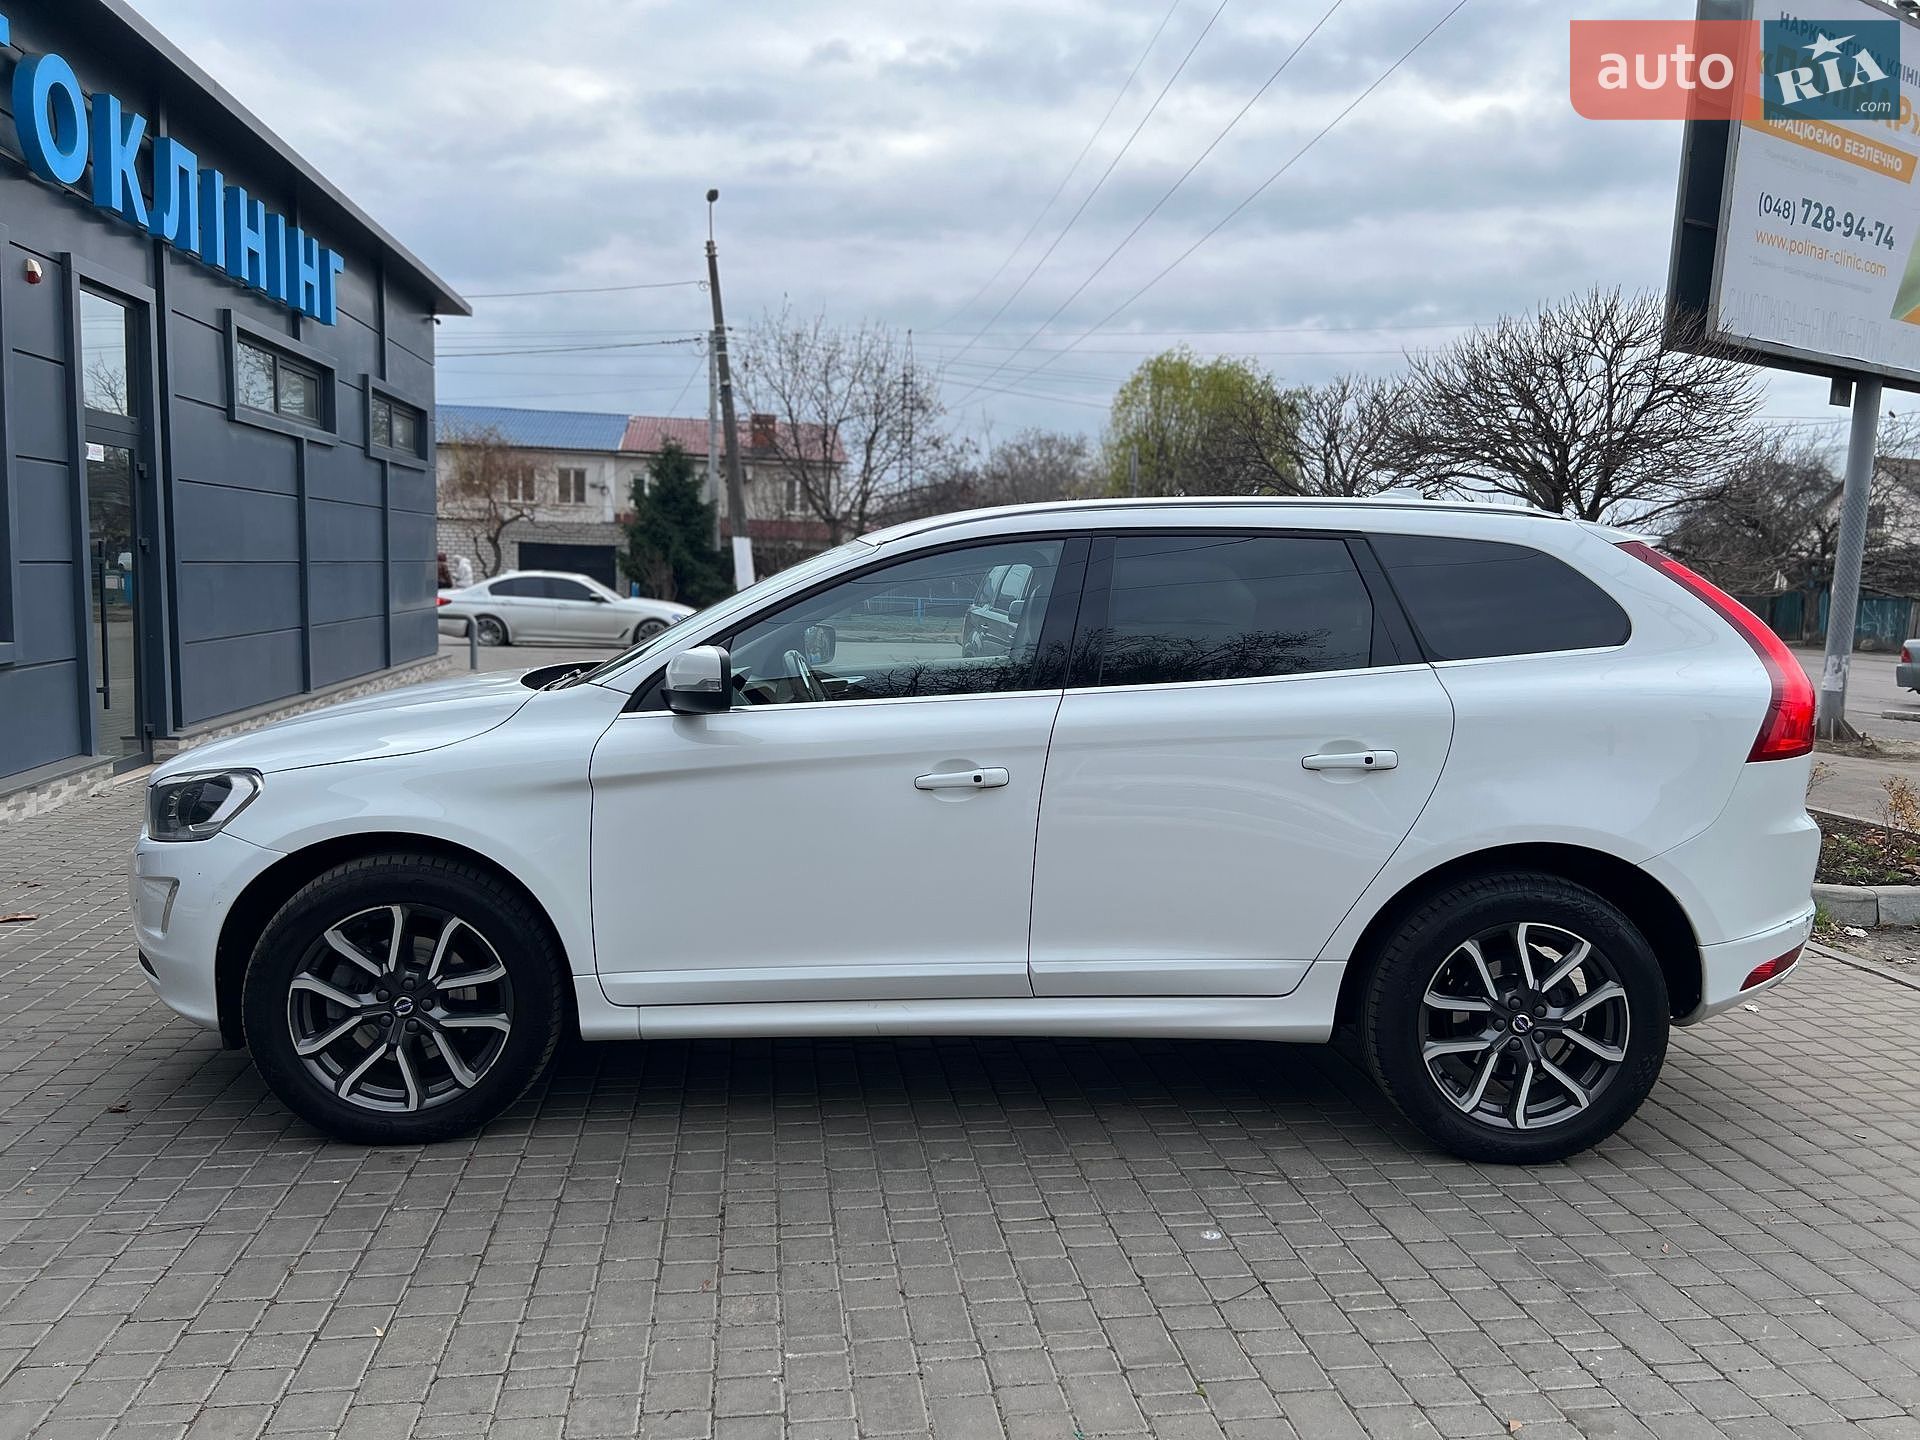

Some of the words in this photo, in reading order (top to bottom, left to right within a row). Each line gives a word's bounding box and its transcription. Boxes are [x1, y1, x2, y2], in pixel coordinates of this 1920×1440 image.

[1886, 56, 1920, 88] КЛІНІ
[0, 12, 344, 326] ОКЛІНІНГ
[1768, 111, 1842, 149] ПРАЦЮЄМО
[1844, 138, 1903, 172] БЕЗПЕЧНО
[1758, 191, 1797, 226] (048)
[1801, 197, 1895, 251] 728-94-74
[1755, 230, 1888, 278] www.polinar-clinic.com
